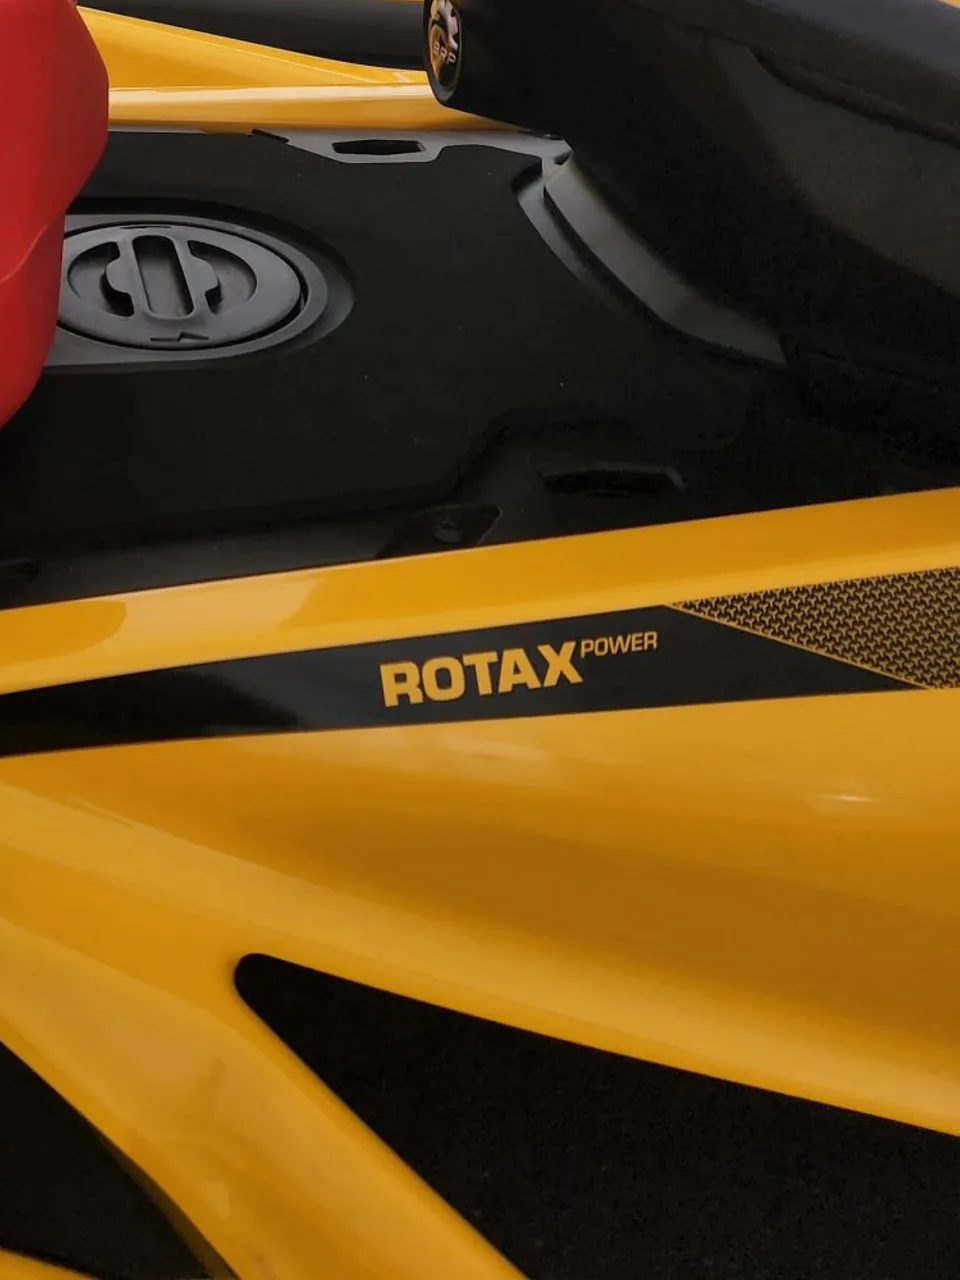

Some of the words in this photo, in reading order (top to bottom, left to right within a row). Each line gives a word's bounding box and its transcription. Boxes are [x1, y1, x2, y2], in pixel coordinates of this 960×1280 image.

[433, 41, 456, 65] BRP
[380, 641, 584, 707] ROTAX
[580, 631, 658, 658] POWER
